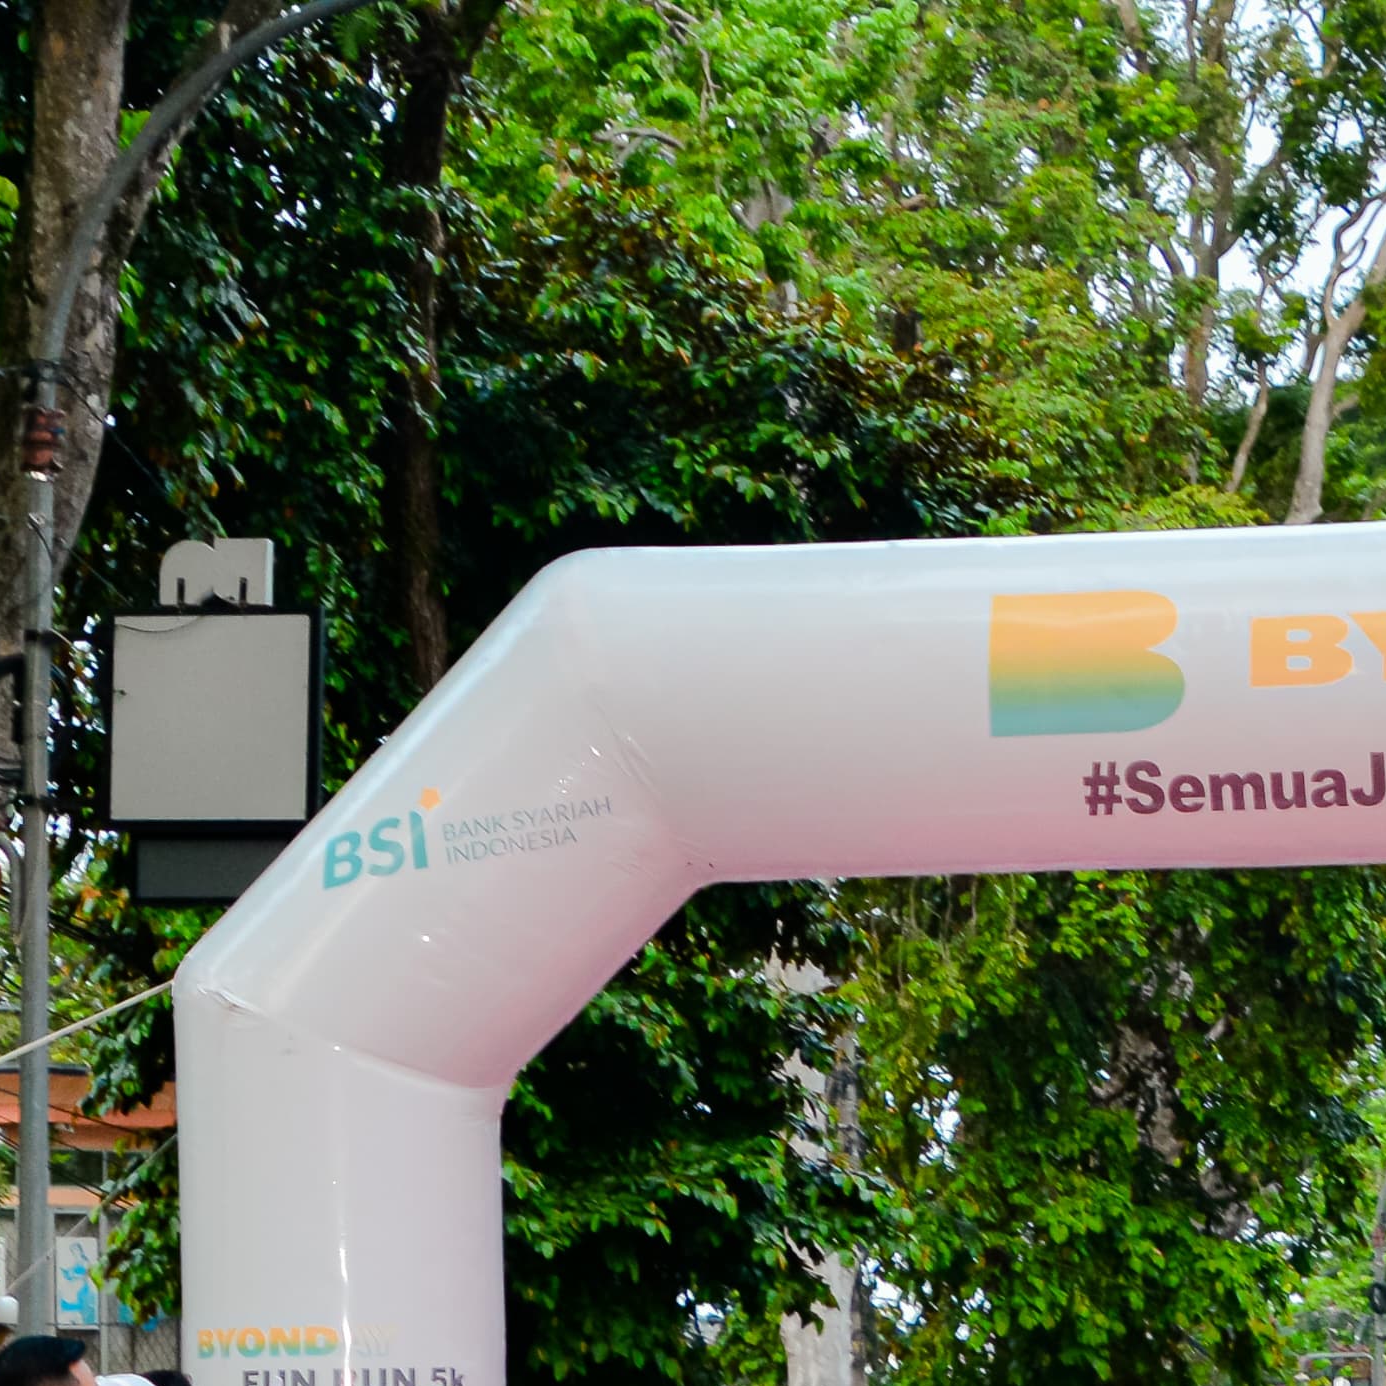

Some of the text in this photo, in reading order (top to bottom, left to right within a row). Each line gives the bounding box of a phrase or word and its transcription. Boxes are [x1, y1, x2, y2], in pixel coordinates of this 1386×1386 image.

[323, 787, 441, 889] BSI
[442, 796, 612, 842] BANK SYARIAH
[445, 827, 578, 865] INDONESIA
[197, 1325, 339, 1359] BYOND
